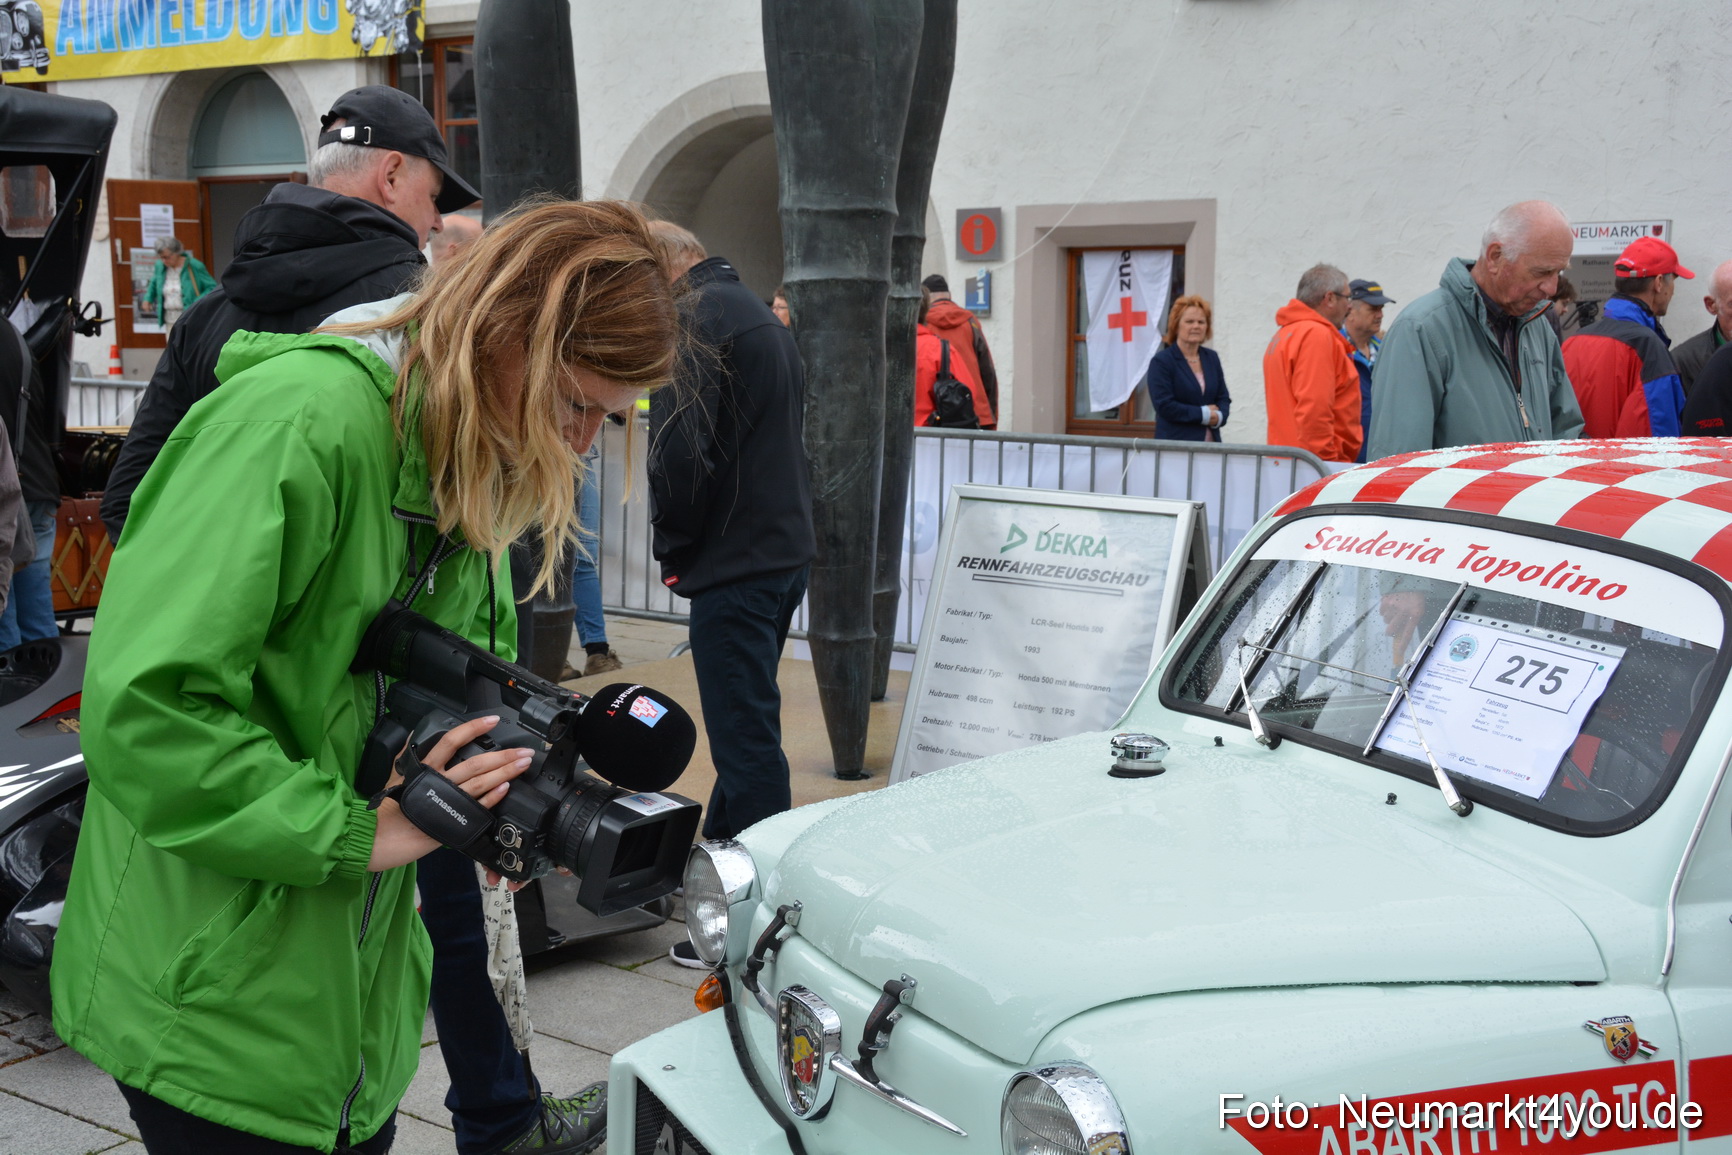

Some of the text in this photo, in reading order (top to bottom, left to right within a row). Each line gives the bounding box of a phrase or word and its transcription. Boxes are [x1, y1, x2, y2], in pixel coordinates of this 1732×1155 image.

[55, 0, 340, 56] ANMELDUNG
[1571, 225, 1648, 239] NEUMARKT
[1034, 530, 1108, 559] DEKRA
[957, 555, 1150, 588] RENNFAHRZEUGSCHAU
[1304, 526, 1628, 601] Scuderia Topolino
[945, 607, 974, 618] Fabrikat
[978, 611, 993, 621] Typ:
[939, 634, 1041, 654] Baujahr: 1993
[933, 661, 954, 671] Motor
[954, 665, 983, 675] Fabrikat
[988, 668, 1003, 679] Typ:
[1018, 673, 1040, 683] Honda
[1041, 675, 1054, 684] 500
[1054, 678, 1067, 687] mit
[1068, 680, 1111, 693] Membranen
[1495, 655, 1569, 695] 275
[978, 696, 994, 705] ccm
[1012, 701, 1046, 714] Leistung:
[1051, 706, 1063, 715] 192
[1064, 708, 1076, 717] PS
[921, 716, 954, 727] Drehzahl:
[958, 721, 981, 732] 12.000
[916, 743, 944, 755] Getriebe
[426, 788, 468, 826] Panasonic
[1602, 1016, 1631, 1025] ABARTH
[1318, 1101, 1498, 1155] ABARTH
[1612, 1079, 1667, 1132] TC
